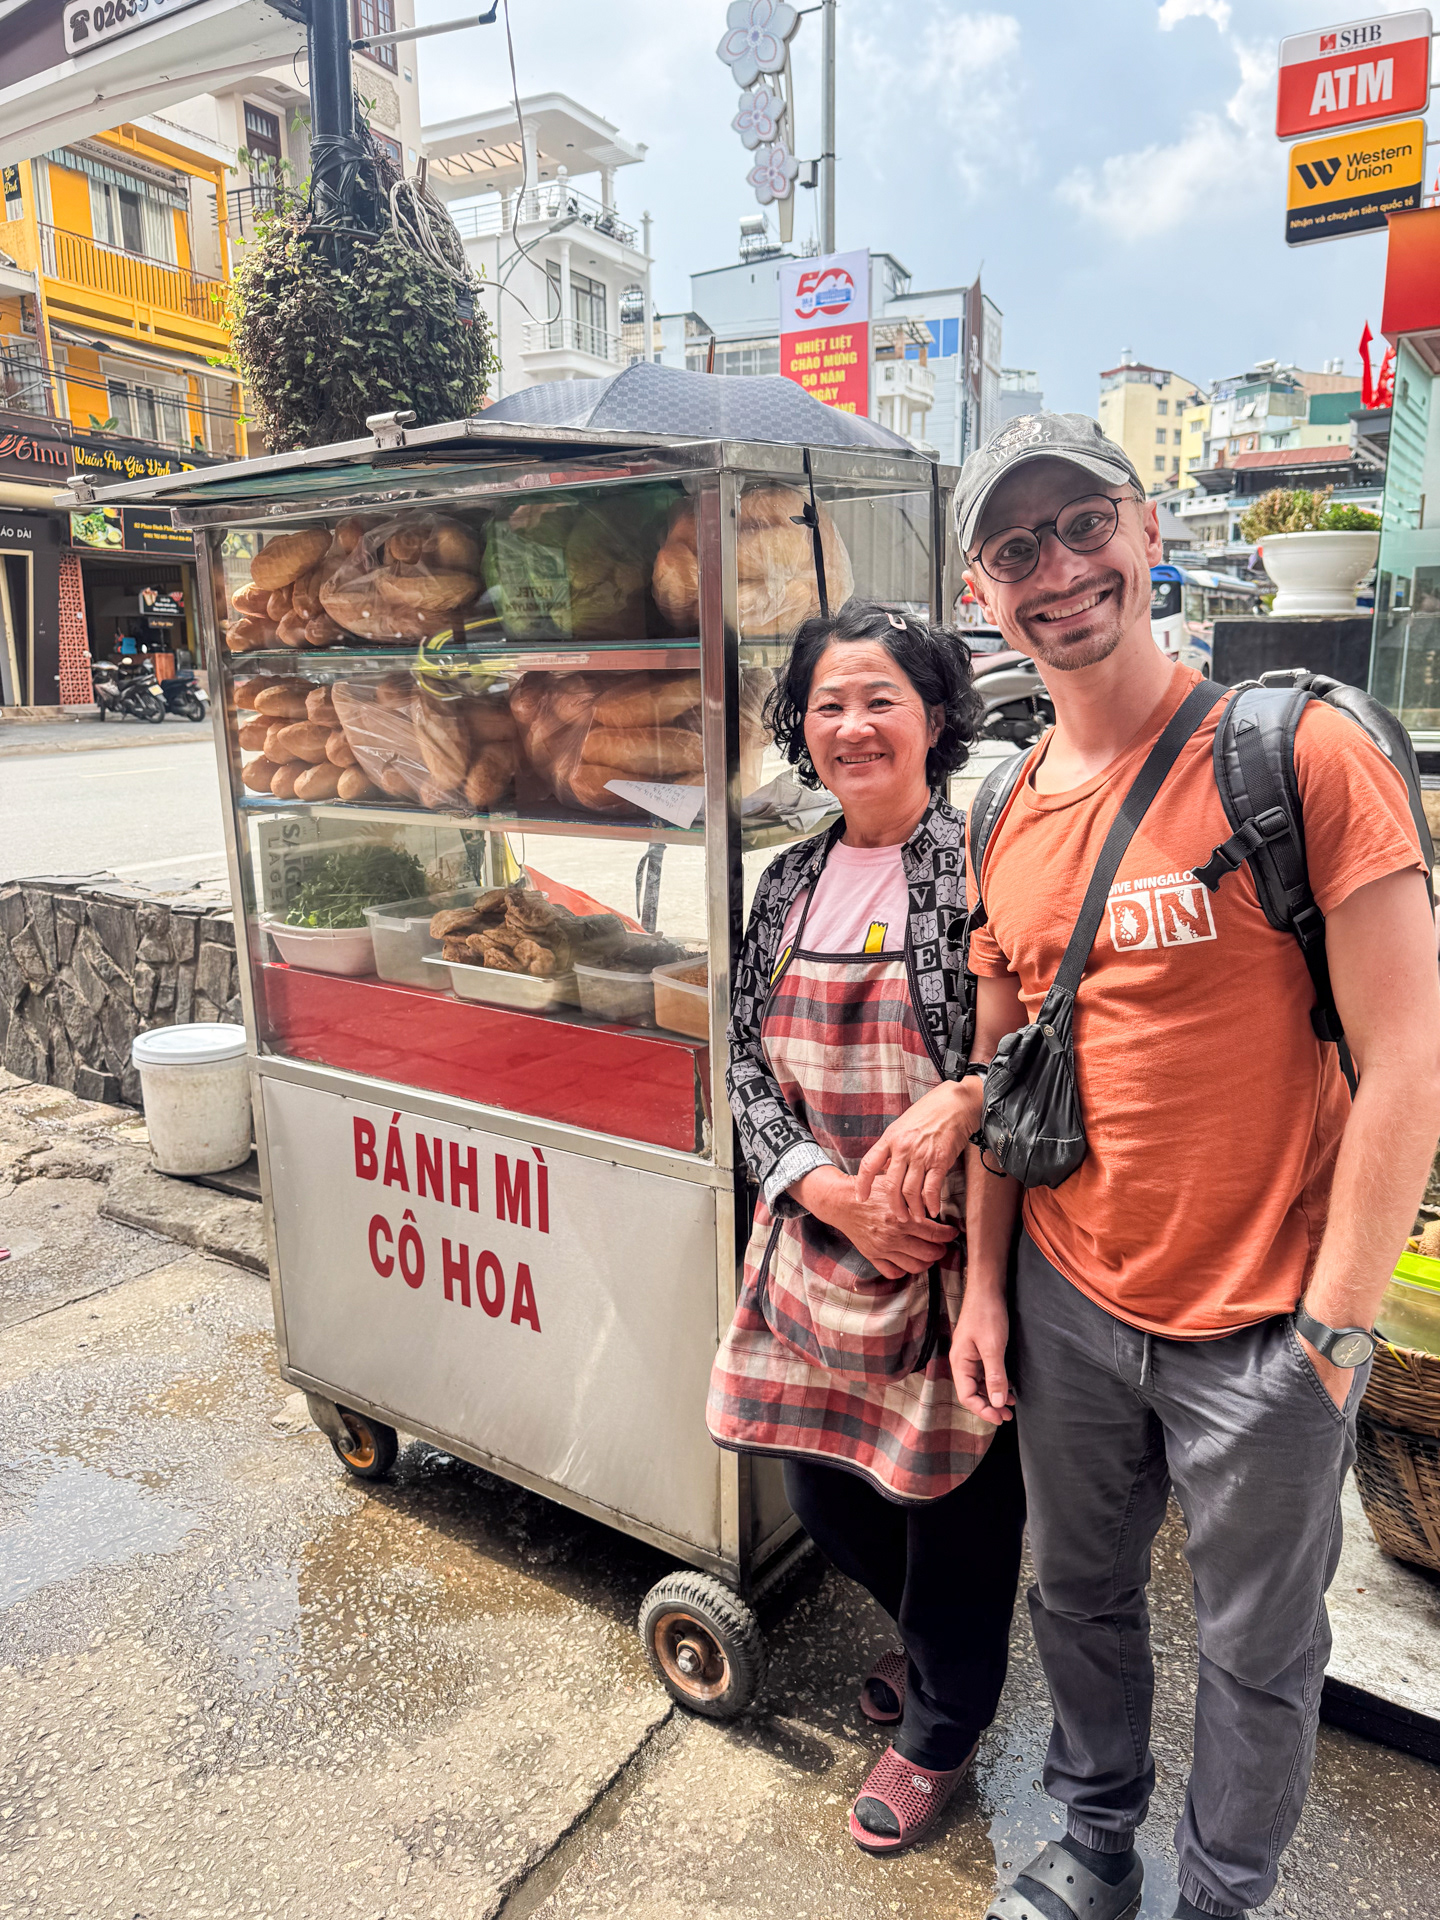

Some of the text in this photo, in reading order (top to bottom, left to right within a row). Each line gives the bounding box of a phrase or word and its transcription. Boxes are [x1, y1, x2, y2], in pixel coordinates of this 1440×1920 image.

[1340, 24, 1382, 48] SHB
[1308, 57, 1394, 116] ATM
[1346, 144, 1412, 168] Western
[1346, 163, 1392, 182] Union
[1314, 214, 1326, 224] và
[1379, 198, 1403, 212] quốc
[1404, 194, 1414, 207] tế
[795, 268, 855, 319] 50
[794, 334, 853, 356] NHIỆT LIỆT
[790, 356, 821, 372] CHÀO
[801, 373, 818, 387] 50
[16, 526, 32, 539] DÀI
[1133, 870, 1196, 891] NINGALO
[353, 1111, 550, 1235] BÁNH MÌ
[368, 1208, 542, 1334] CÔ HOA
